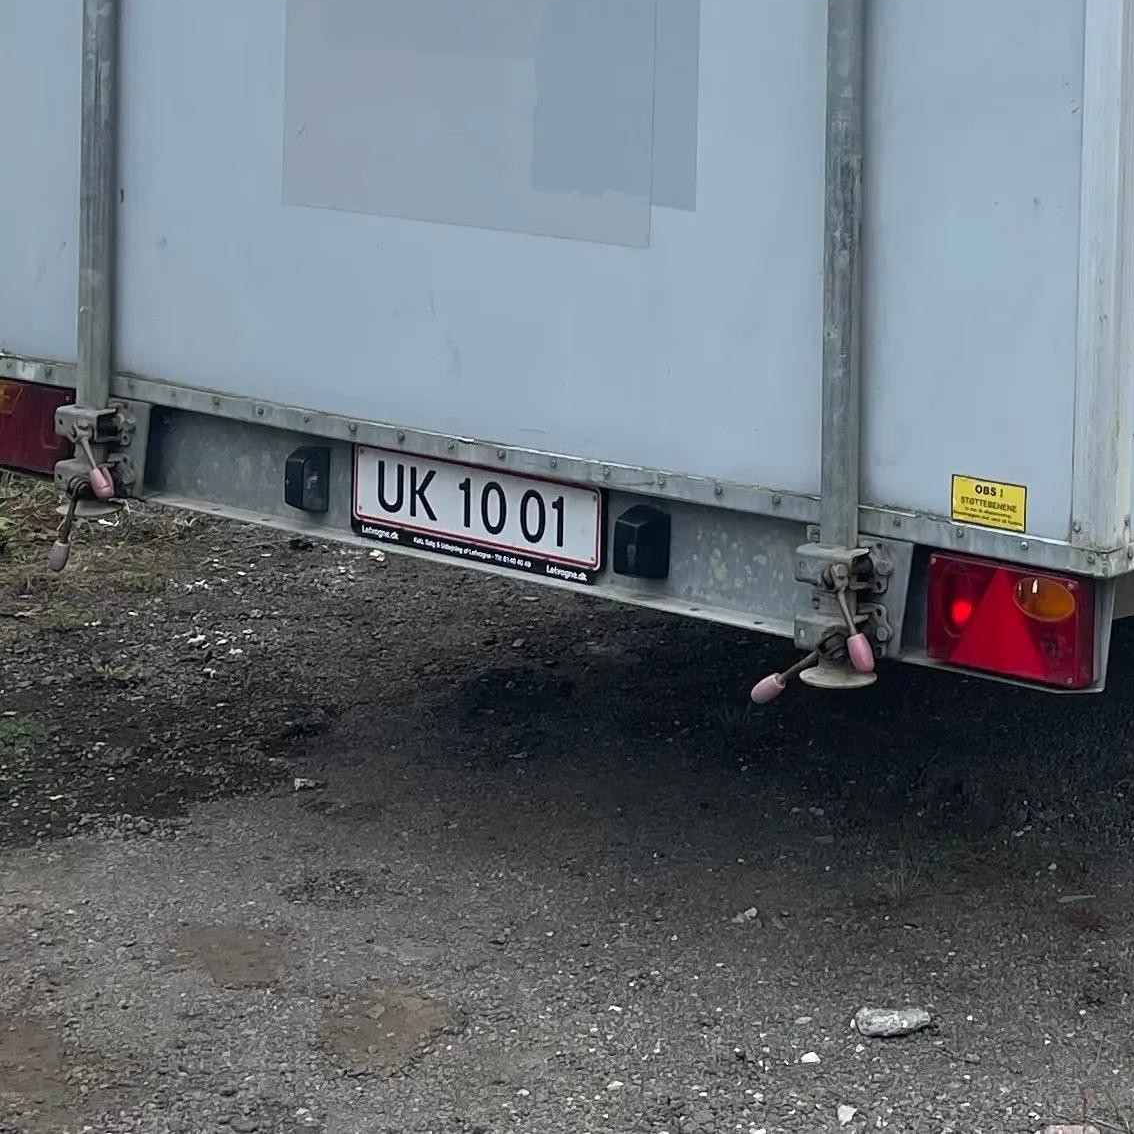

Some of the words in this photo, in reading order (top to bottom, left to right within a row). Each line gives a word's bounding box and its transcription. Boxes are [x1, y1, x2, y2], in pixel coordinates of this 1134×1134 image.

[377, 460, 438, 521] UK
[458, 477, 507, 535] 10
[519, 489, 564, 547] 01
[975, 484, 997, 497] OBS
